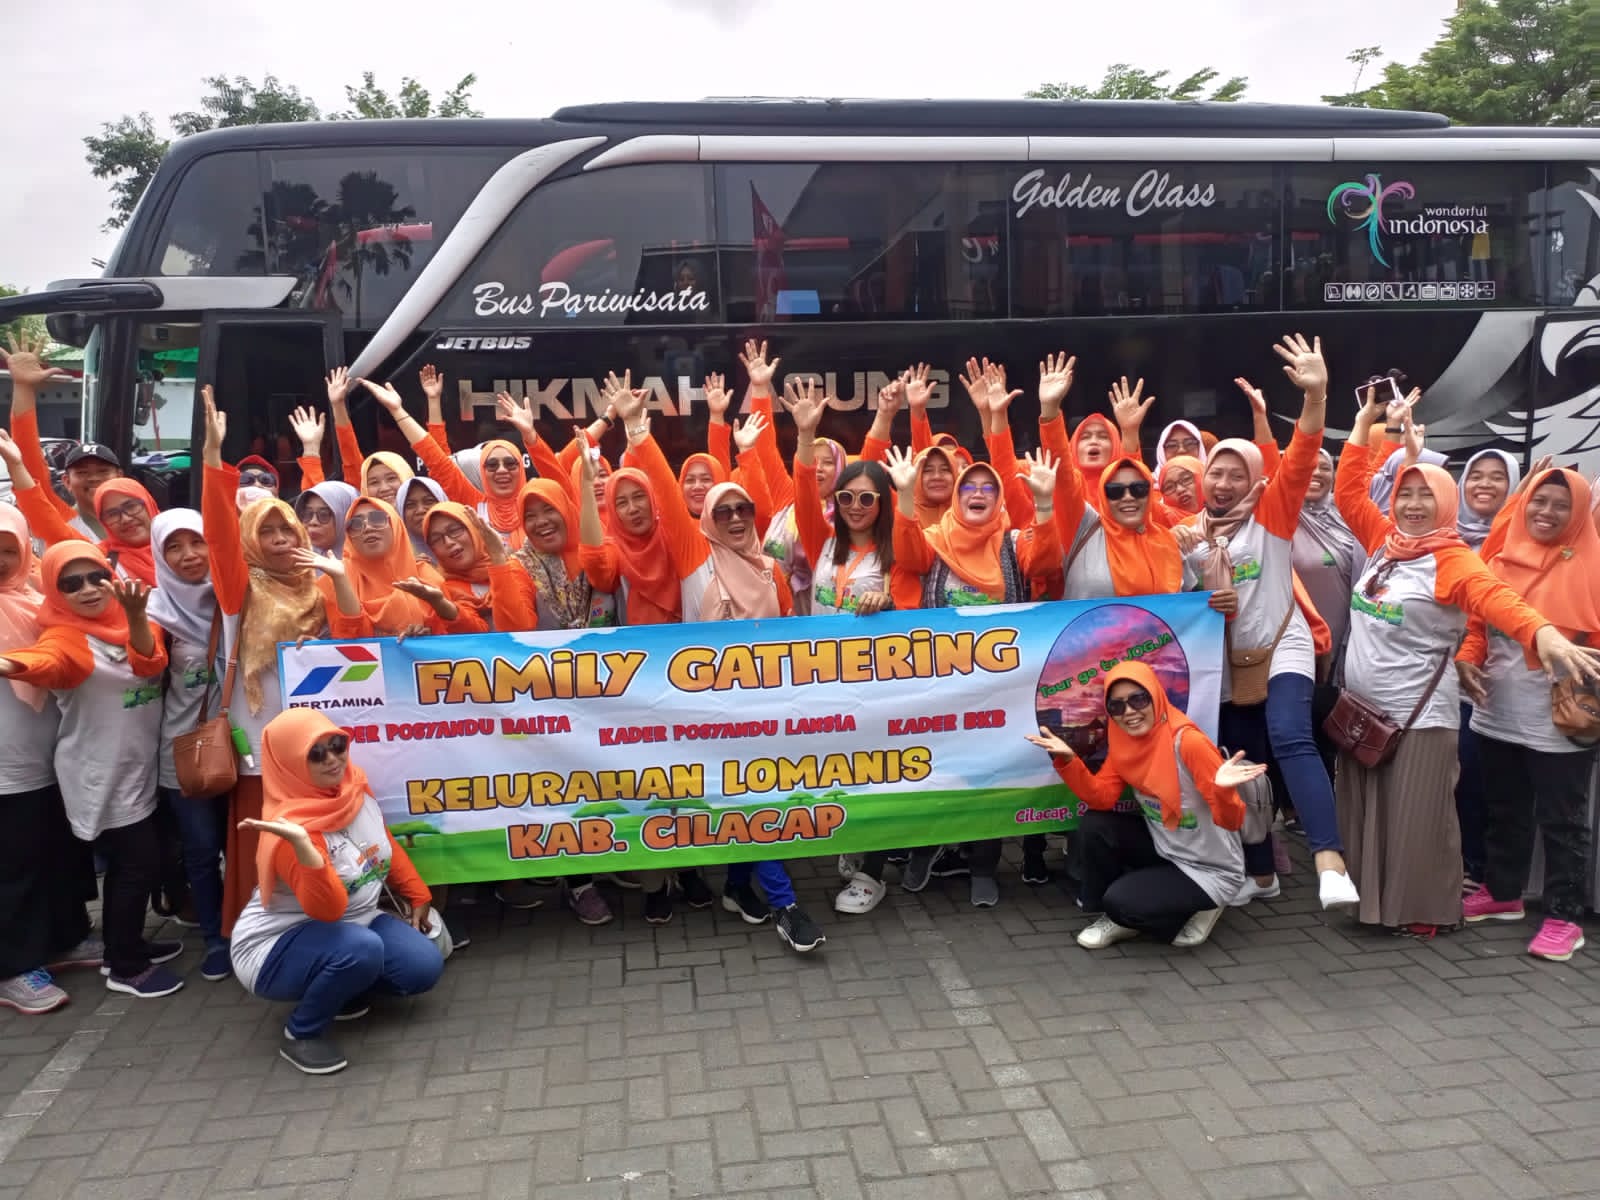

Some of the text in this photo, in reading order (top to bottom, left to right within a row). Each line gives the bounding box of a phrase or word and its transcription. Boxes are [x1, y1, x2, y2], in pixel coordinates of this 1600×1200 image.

[1012, 168, 1216, 218] Golden Class
[1390, 215, 1490, 234] indonesia
[1425, 206, 1488, 217] wonderful
[472, 281, 710, 318] Bus Pariwisata
[436, 336, 533, 350] JETBUS
[1077, 667, 1098, 685] go
[289, 697, 385, 709] PERTAMINA
[385, 717, 496, 742] POSYANDU
[598, 724, 668, 746] KADER
[672, 719, 779, 742] POSYANDU
[887, 709, 1006, 737] KADER BKB
[406, 746, 933, 815] KELURAHAN LOMANIS
[508, 804, 848, 861] KAB. CILACAP
